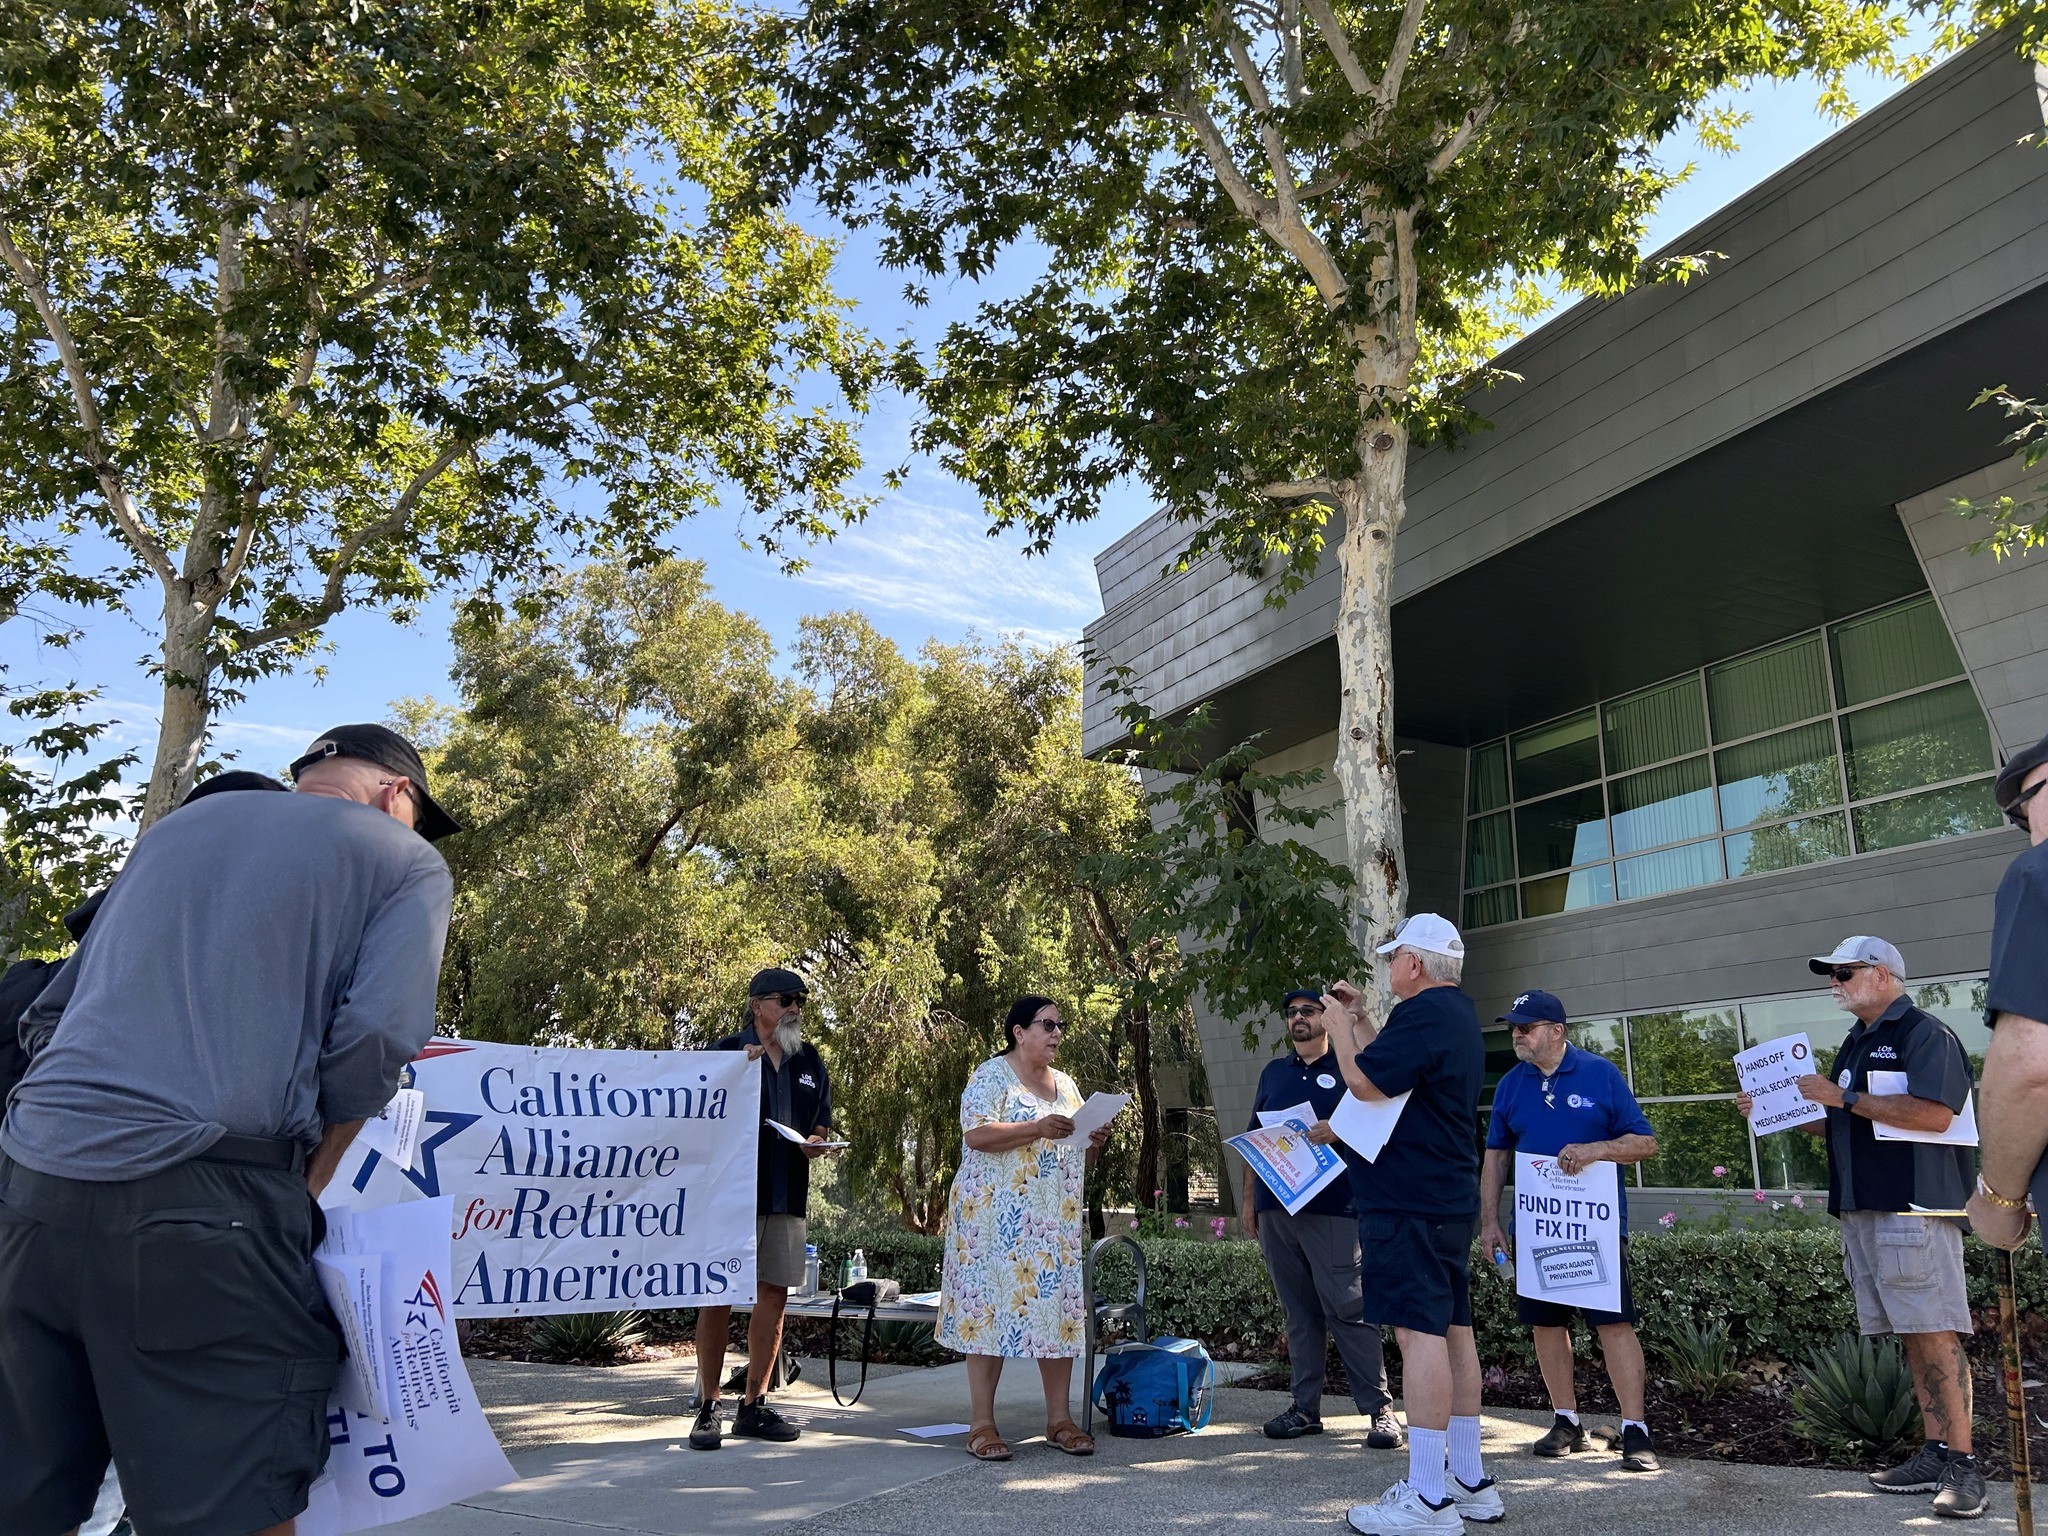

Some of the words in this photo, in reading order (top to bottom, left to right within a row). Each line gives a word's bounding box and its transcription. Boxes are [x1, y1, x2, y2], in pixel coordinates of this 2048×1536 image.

[1744, 1057, 1769, 1074] HANDS
[1768, 1051, 1785, 1065] OFF
[1869, 1051, 1898, 1060] RUCOS
[1877, 1045, 1893, 1053] LOS
[480, 1066, 728, 1120] California
[1747, 1085, 1770, 1099] SOCIAL
[475, 1124, 680, 1179] Alliance
[1276, 1149, 1296, 1172] Improve
[1294, 1170, 1301, 1178] &
[1257, 1161, 1267, 1173] the
[1263, 1148, 1281, 1167] Social
[1278, 1164, 1298, 1189] Security
[452, 1198, 513, 1240] for
[504, 1187, 687, 1240] Retired
[1518, 1193, 1562, 1215] FUND
[1565, 1199, 1582, 1218] IT
[1584, 1201, 1610, 1221] TO
[1535, 1218, 1562, 1239] FIX
[1565, 1222, 1587, 1242] IT!
[1534, 1247, 1559, 1258] SOCIAL
[1543, 1262, 1568, 1272] SENIORS
[1568, 1259, 1594, 1270] AGAINST
[1549, 1269, 1593, 1280] PRIVATIZATION
[405, 1346, 431, 1409] Retired
[414, 1331, 440, 1401] Alliance
[429, 1328, 461, 1415] California
[363, 1433, 406, 1497] TO
